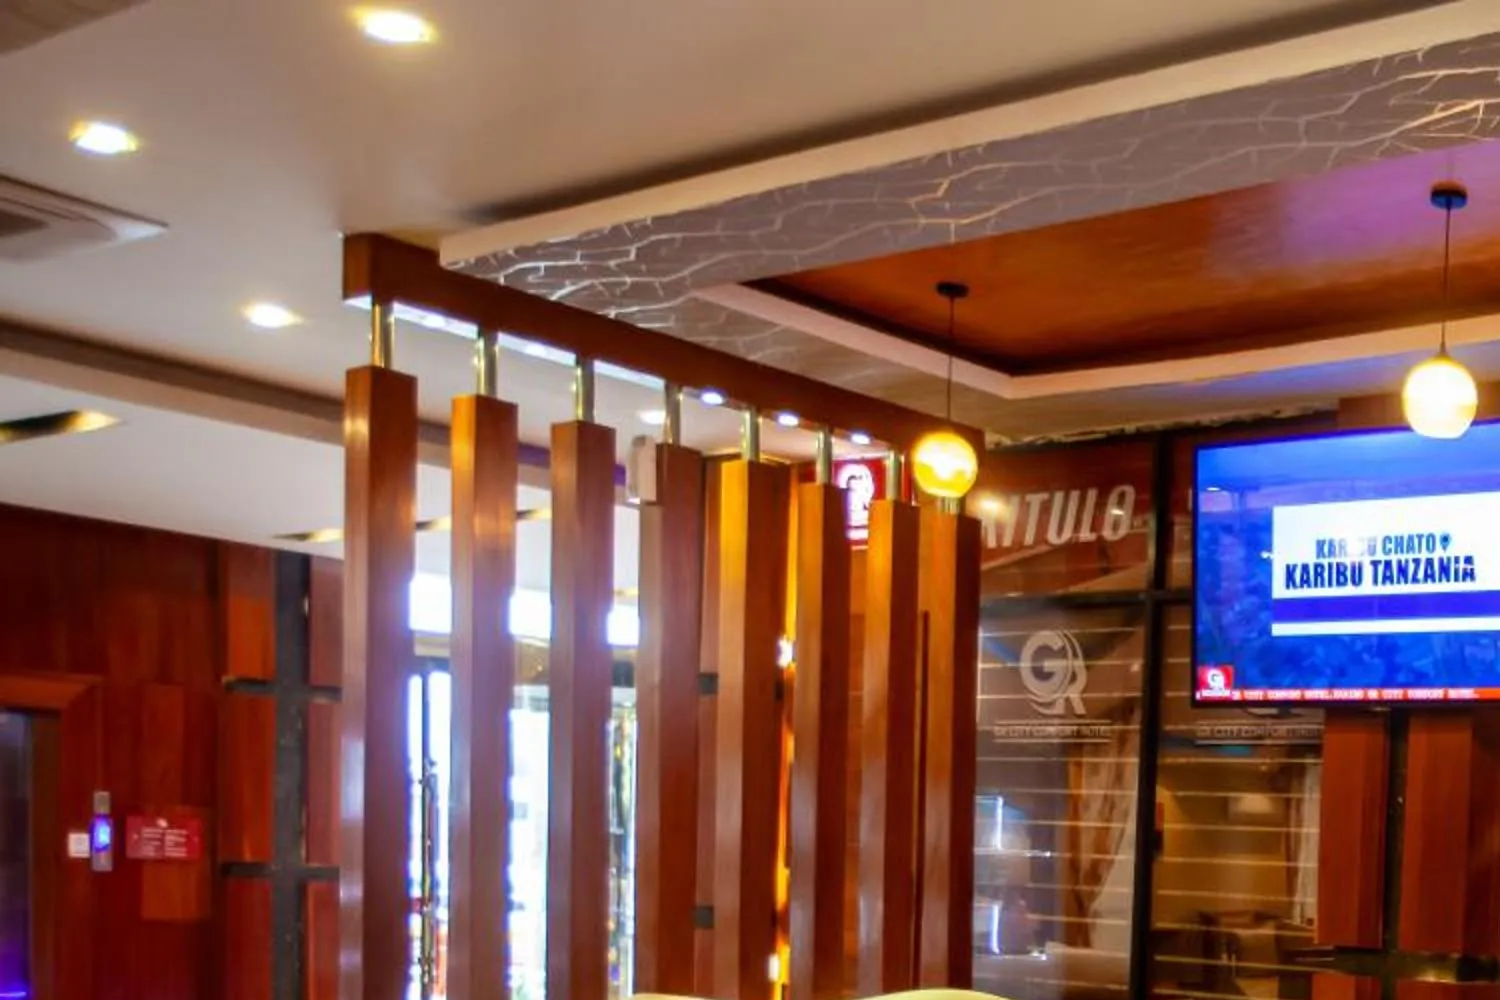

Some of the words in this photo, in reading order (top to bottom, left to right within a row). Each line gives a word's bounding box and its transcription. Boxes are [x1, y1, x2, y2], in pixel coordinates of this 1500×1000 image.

[1315, 538, 1377, 559] KARU
[1381, 533, 1437, 556] CHATO
[1285, 561, 1364, 590] KARIBU
[1370, 556, 1477, 586] TANZANIA
